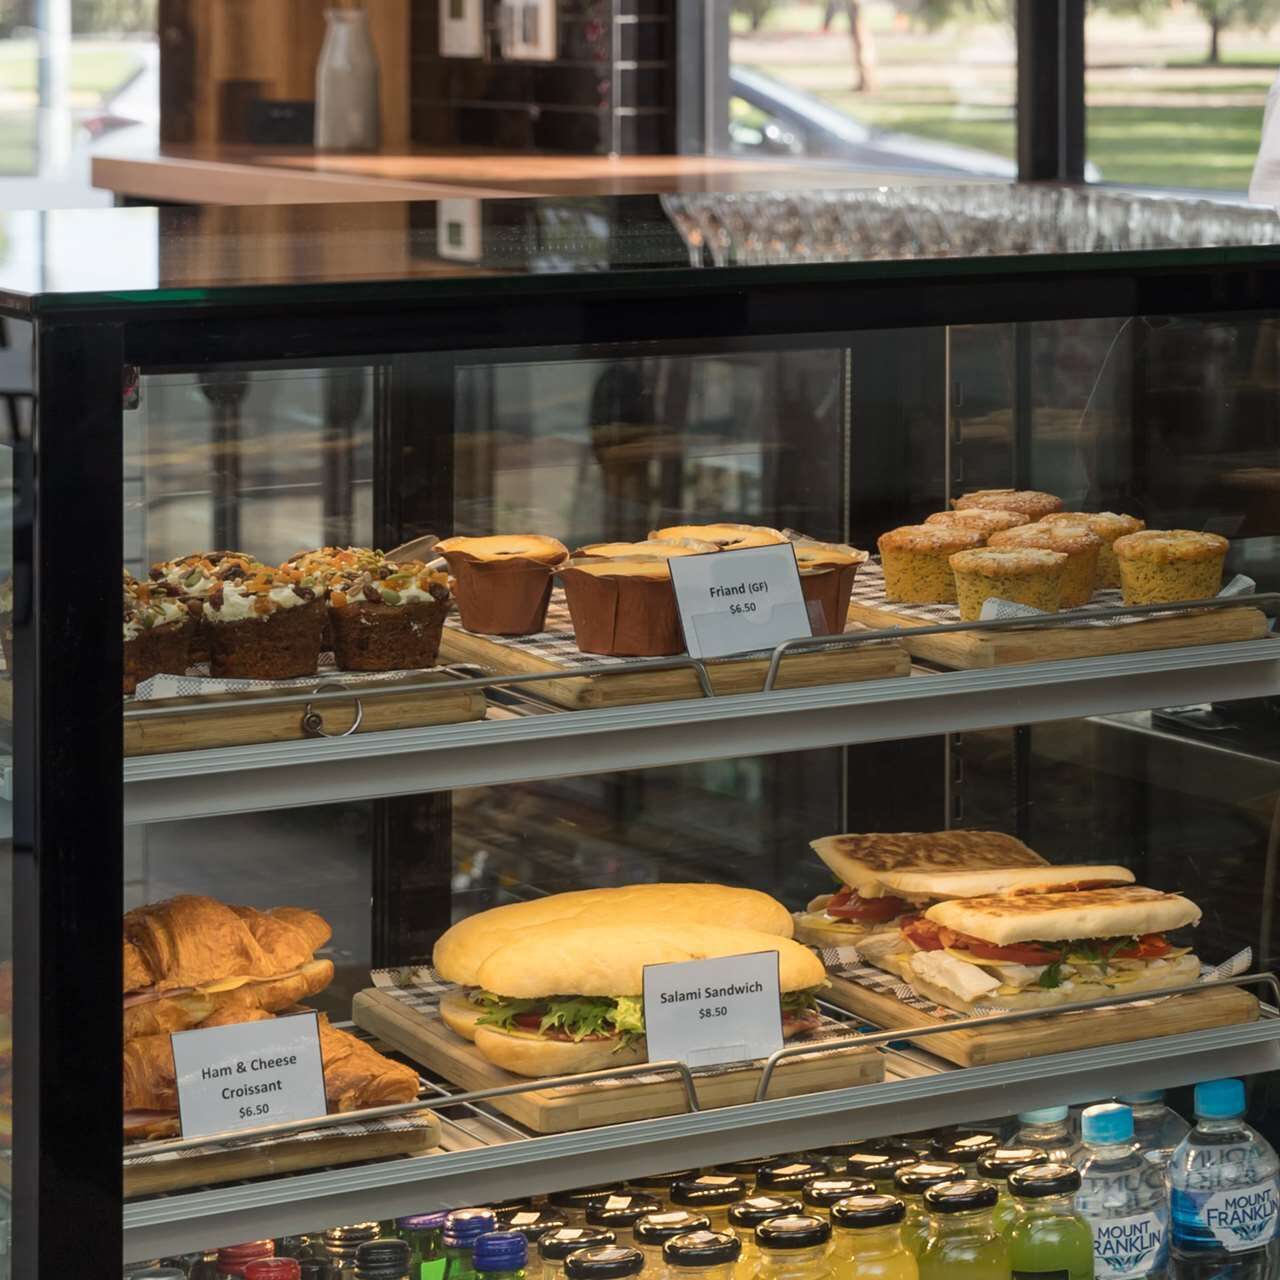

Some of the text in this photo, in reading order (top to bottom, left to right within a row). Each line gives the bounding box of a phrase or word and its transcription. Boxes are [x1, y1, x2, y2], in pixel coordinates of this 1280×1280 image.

[709, 581, 769, 598] Friand (GF)
[729, 602, 757, 614] $6.50
[660, 981, 763, 1004] Salami Sandwich
[699, 1006, 728, 1019] $8.50
[202, 1054, 297, 1080] Ham & Cheese
[222, 1079, 283, 1100] Croissant
[239, 1103, 270, 1119] $6.50
[1224, 1188, 1272, 1210] MOUNT
[1207, 1198, 1280, 1226] FRANKLIN
[1098, 1220, 1151, 1238] MOUNT
[1093, 1230, 1161, 1255] RANKLIN
